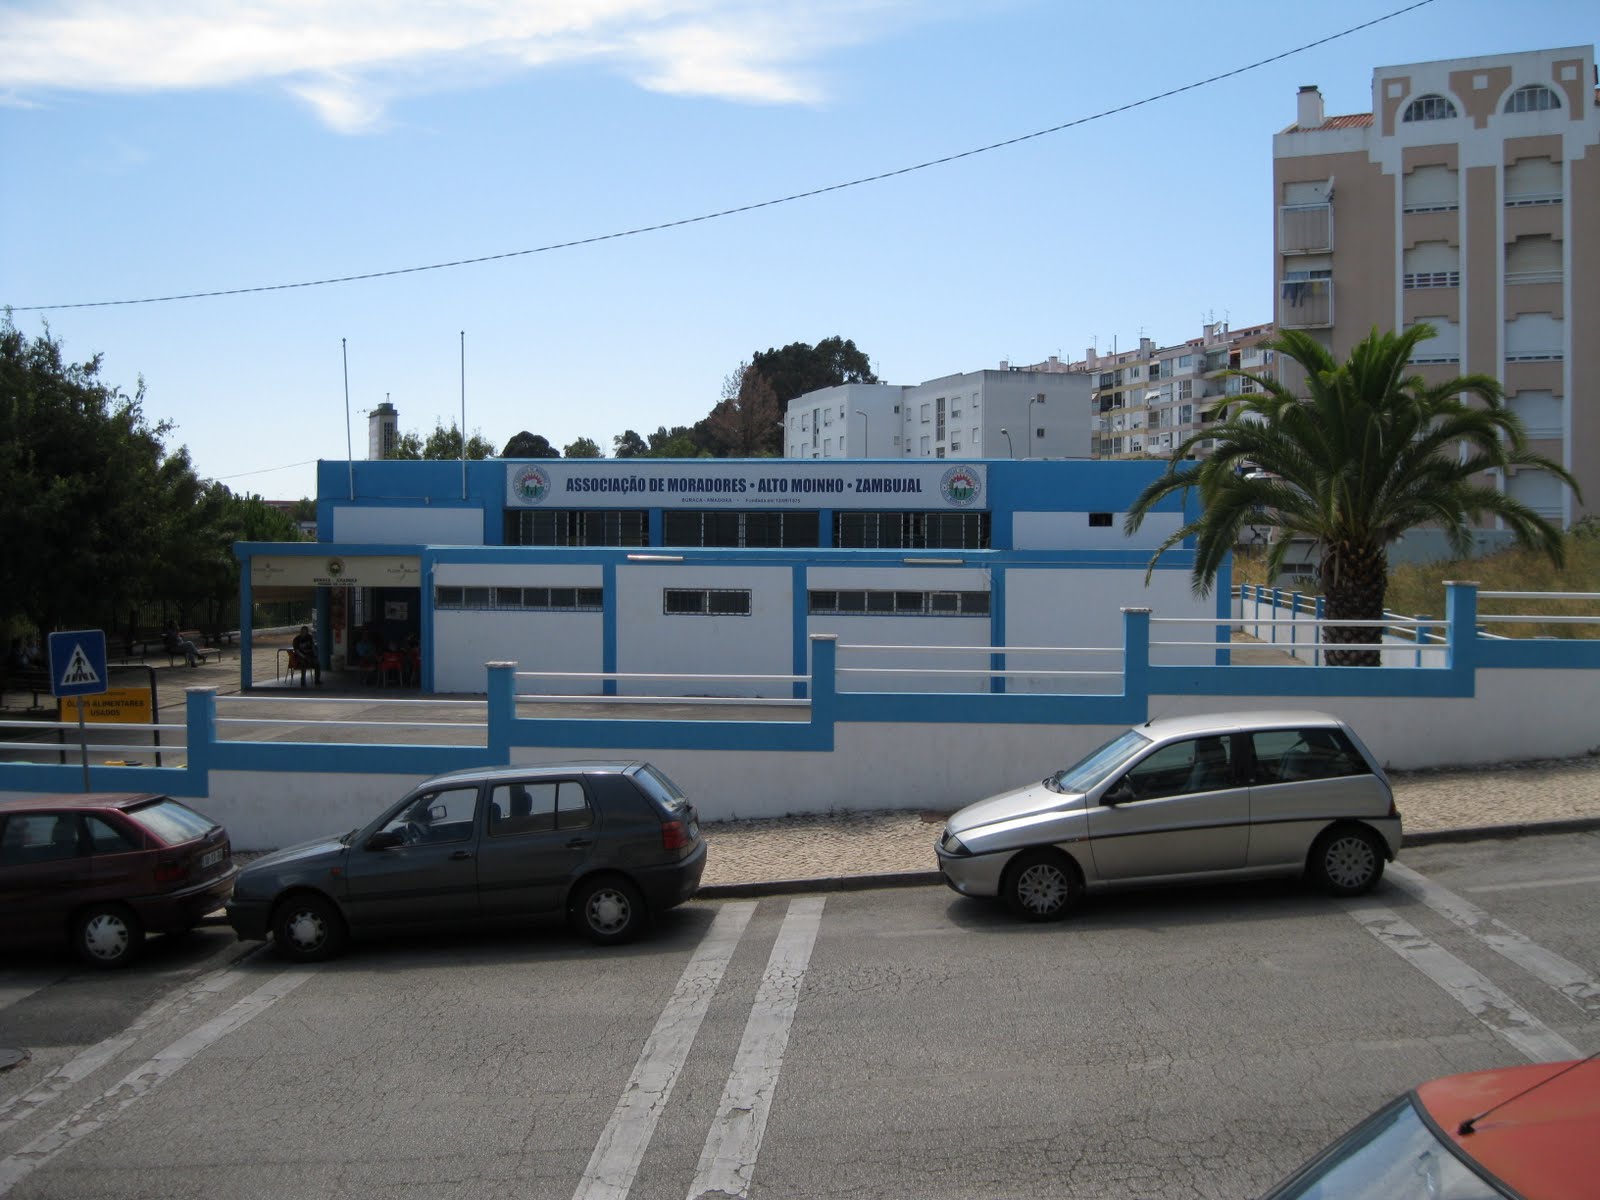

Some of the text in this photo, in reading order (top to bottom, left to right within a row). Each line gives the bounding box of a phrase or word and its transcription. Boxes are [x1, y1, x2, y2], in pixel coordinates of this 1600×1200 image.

[566, 475, 922, 495] ASSOCIAÇÃO DE MORADORES ALTO MOINHO ZAMBUJAL
